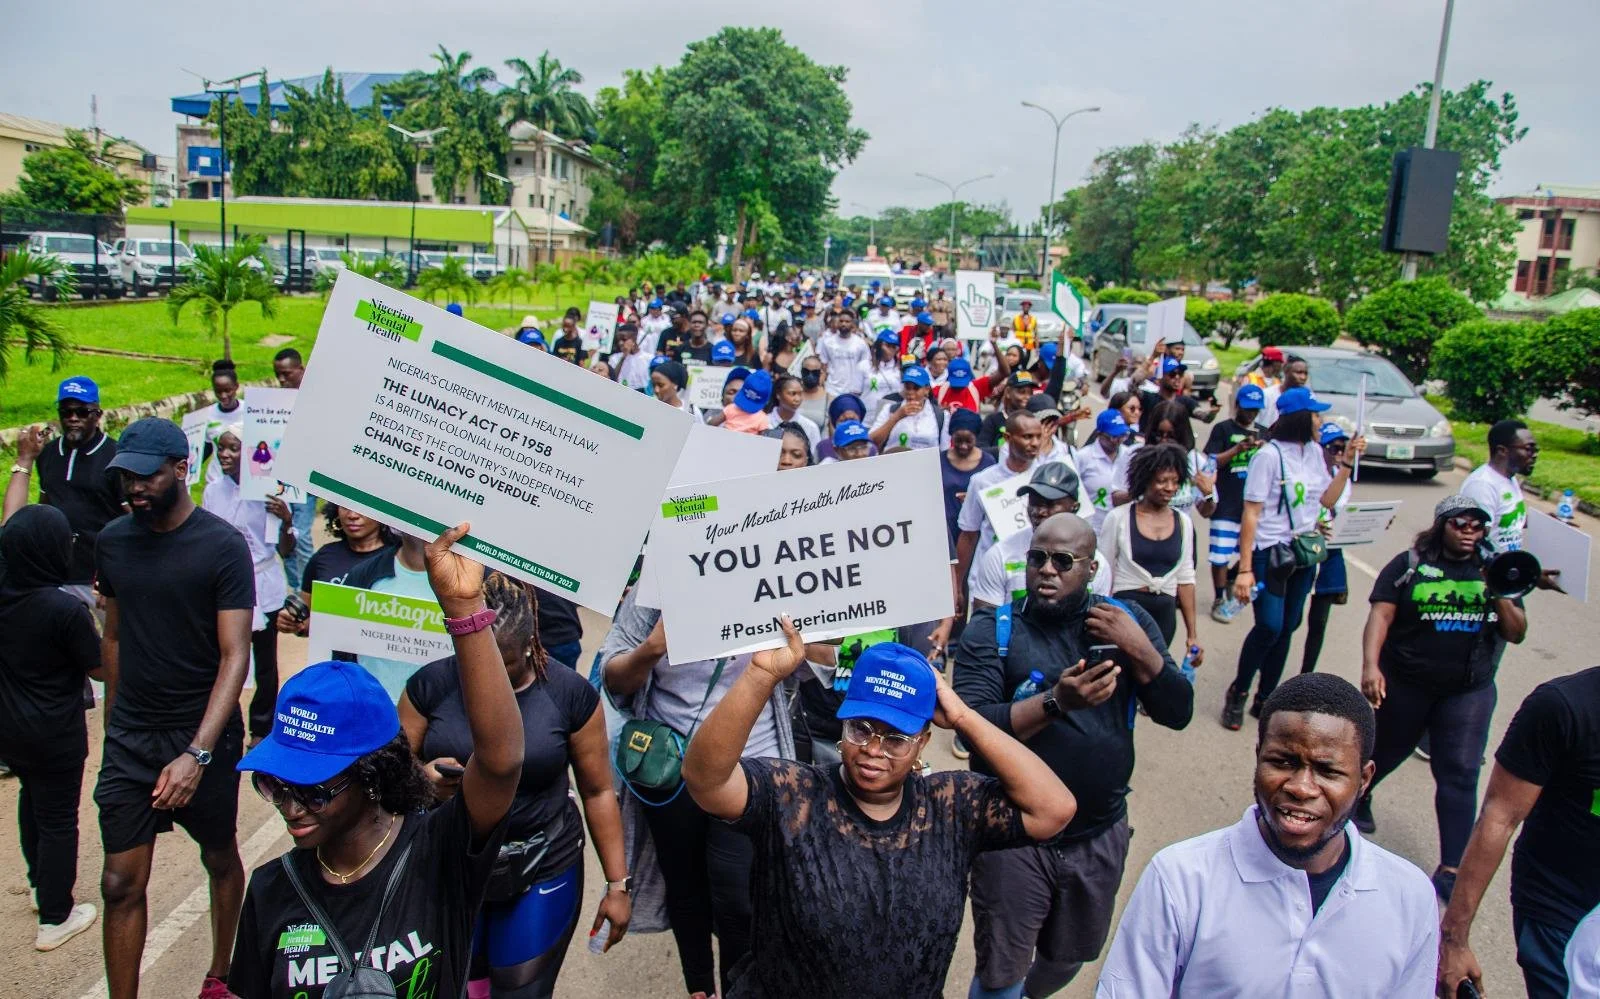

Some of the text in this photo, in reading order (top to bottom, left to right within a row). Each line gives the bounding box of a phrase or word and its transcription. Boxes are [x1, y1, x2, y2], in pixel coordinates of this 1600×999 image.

[369, 298, 415, 324] Nigerian
[370, 311, 407, 333] Mental
[367, 322, 401, 343] Health
[383, 377, 553, 457] THE LUNACY ACT OF 1958
[387, 357, 600, 455] NIGERIA'S CURRENT MENTAL HEALTH LAW,
[375, 393, 585, 488] IS A BRITISH COLONIAL HOLDOVER THAT
[364, 426, 541, 508] CHANGE IS LONG OVERDUE.
[369, 411, 594, 514] PREDATES THE COUNTRY'S INDEPENDENCE.
[352, 444, 485, 506] #PASSNIGERIANMHB
[670, 492, 708, 505] Nigerian
[675, 501, 706, 514] Mental
[676, 511, 706, 523] Health
[705, 480, 885, 544] Your Mental Health Matters
[688, 520, 913, 577] YOU ARE NOT
[475, 542, 574, 589] WORLD MENTAL HEALTH DAY 2022
[753, 563, 862, 603] ALONE
[721, 599, 887, 641] #PassNgerianMHB
[361, 629, 411, 644] NIGERIAN
[387, 643, 429, 657] HEALTH
[865, 676, 890, 687] MENTAL
[890, 681, 917, 696] HEALTH
[880, 669, 905, 682] WORLD
[873, 685, 903, 699] DAY 2022
[277, 712, 336, 736] MENTAL HEALTH
[290, 706, 318, 721] WORLD
[283, 725, 317, 743] DAY 2022
[284, 944, 310, 954] Health
[286, 934, 313, 944] Mental
